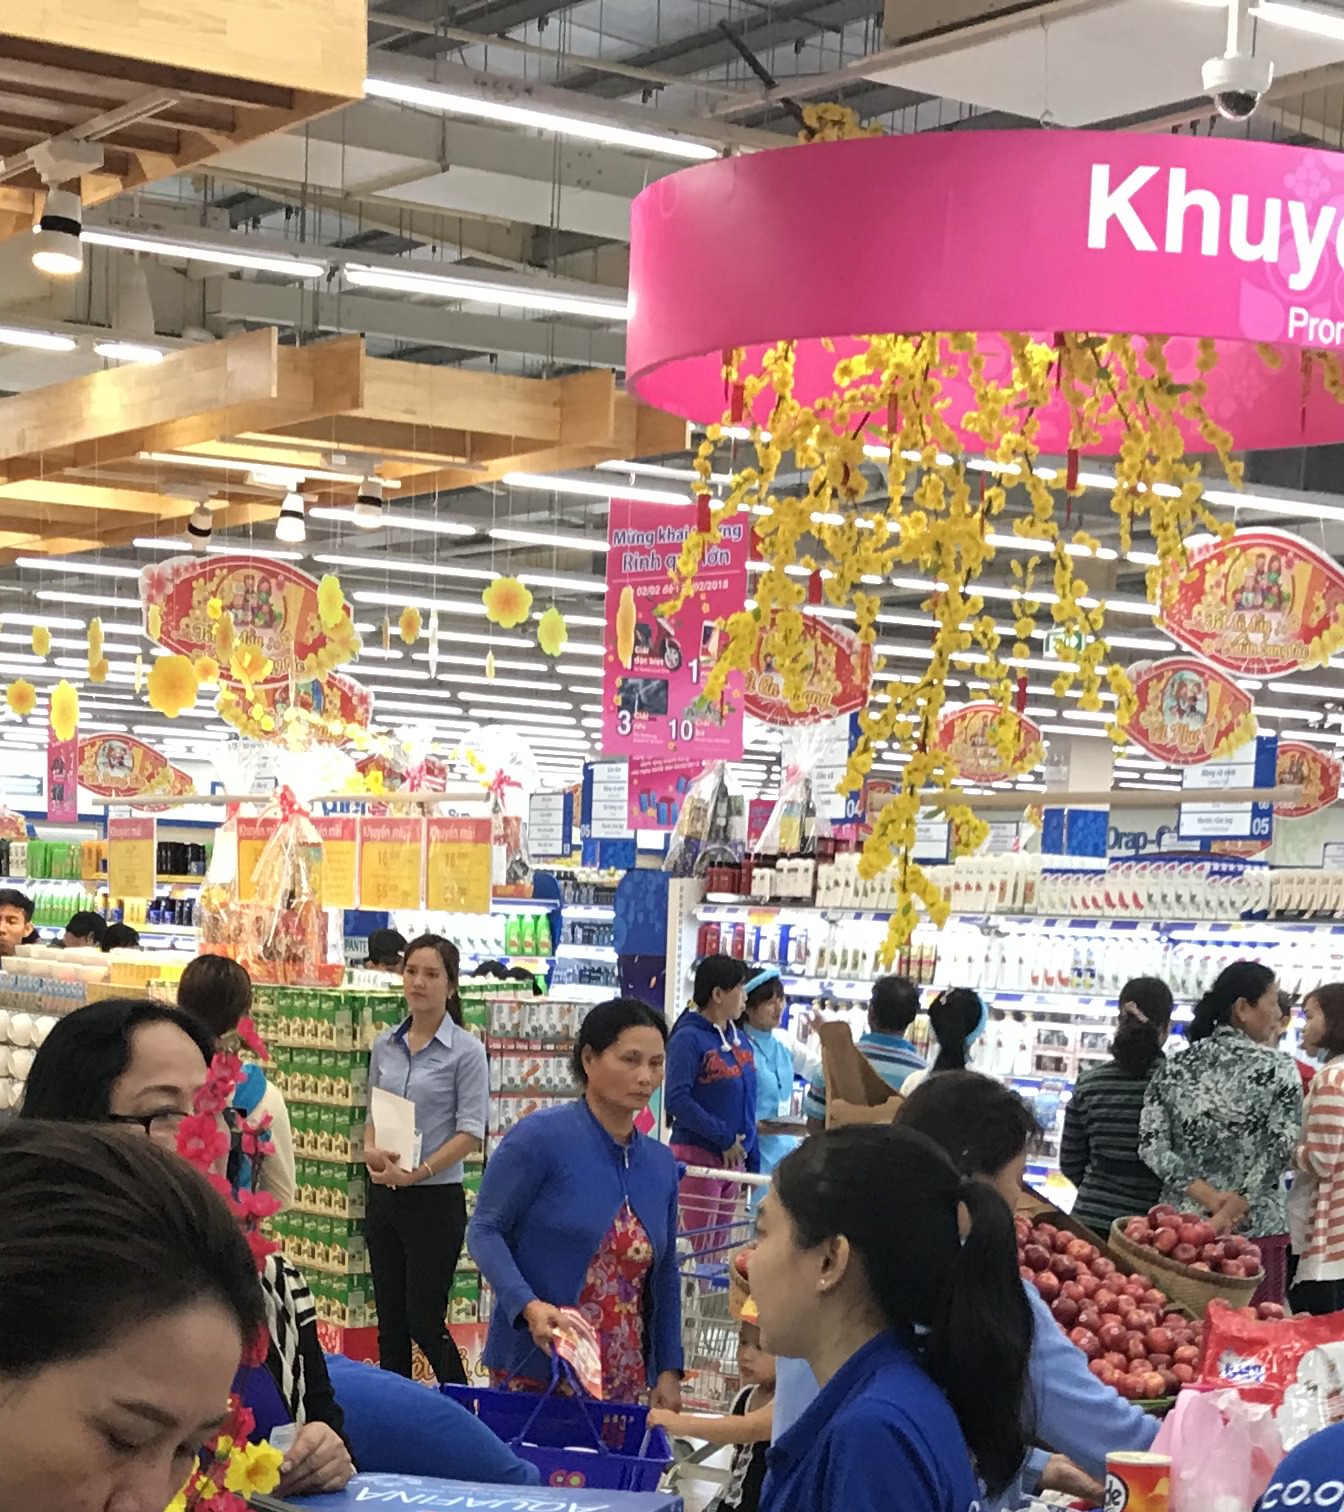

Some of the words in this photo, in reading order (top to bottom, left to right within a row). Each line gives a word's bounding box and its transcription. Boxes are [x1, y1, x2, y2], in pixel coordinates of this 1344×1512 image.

[658, 525, 689, 543] khai
[689, 658, 698, 683] 1
[618, 710, 631, 735] 3
[669, 718, 693, 741] 10
[1252, 818, 1269, 835] 05
